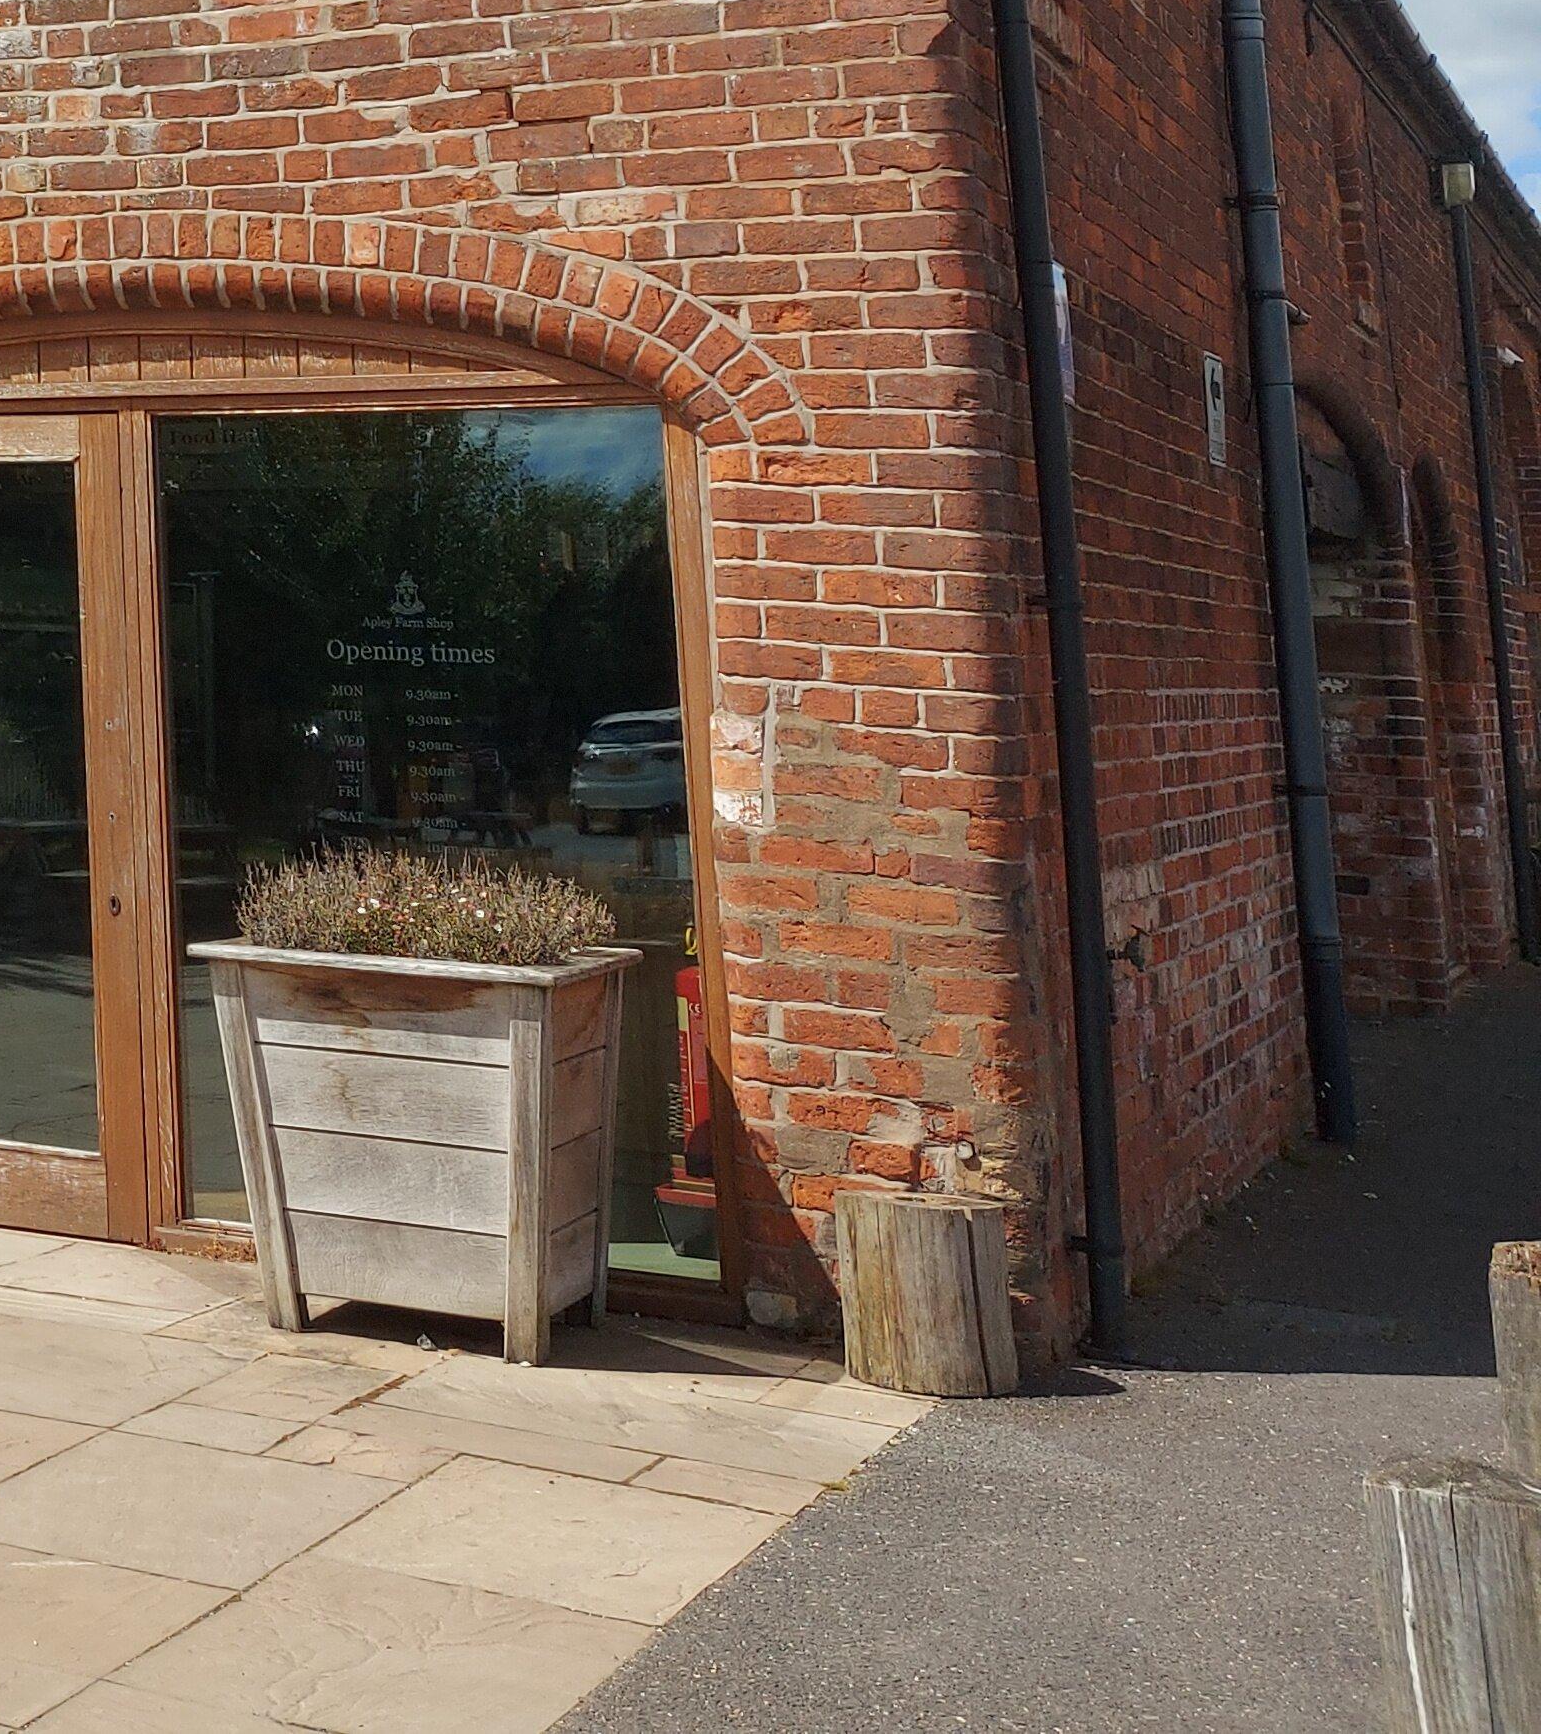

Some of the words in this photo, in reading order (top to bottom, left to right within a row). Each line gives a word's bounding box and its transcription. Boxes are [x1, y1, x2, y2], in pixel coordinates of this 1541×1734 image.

[362, 616, 392, 629] Apley
[395, 617, 424, 628] Farm
[426, 617, 454, 630] Shop
[326, 639, 425, 667] Opening
[430, 641, 495, 664] times
[331, 684, 363, 697] MON
[405, 689, 451, 701] 9.30am
[334, 710, 362, 723] TUE
[406, 715, 452, 727] 9.30am
[334, 735, 365, 748] WED
[407, 740, 454, 752] 9.30am
[335, 760, 365, 773] THU
[409, 765, 455, 777] 9.30am
[337, 786, 361, 798] FRI
[411, 792, 457, 804] 9.30am
[339, 811, 364, 823] SAT
